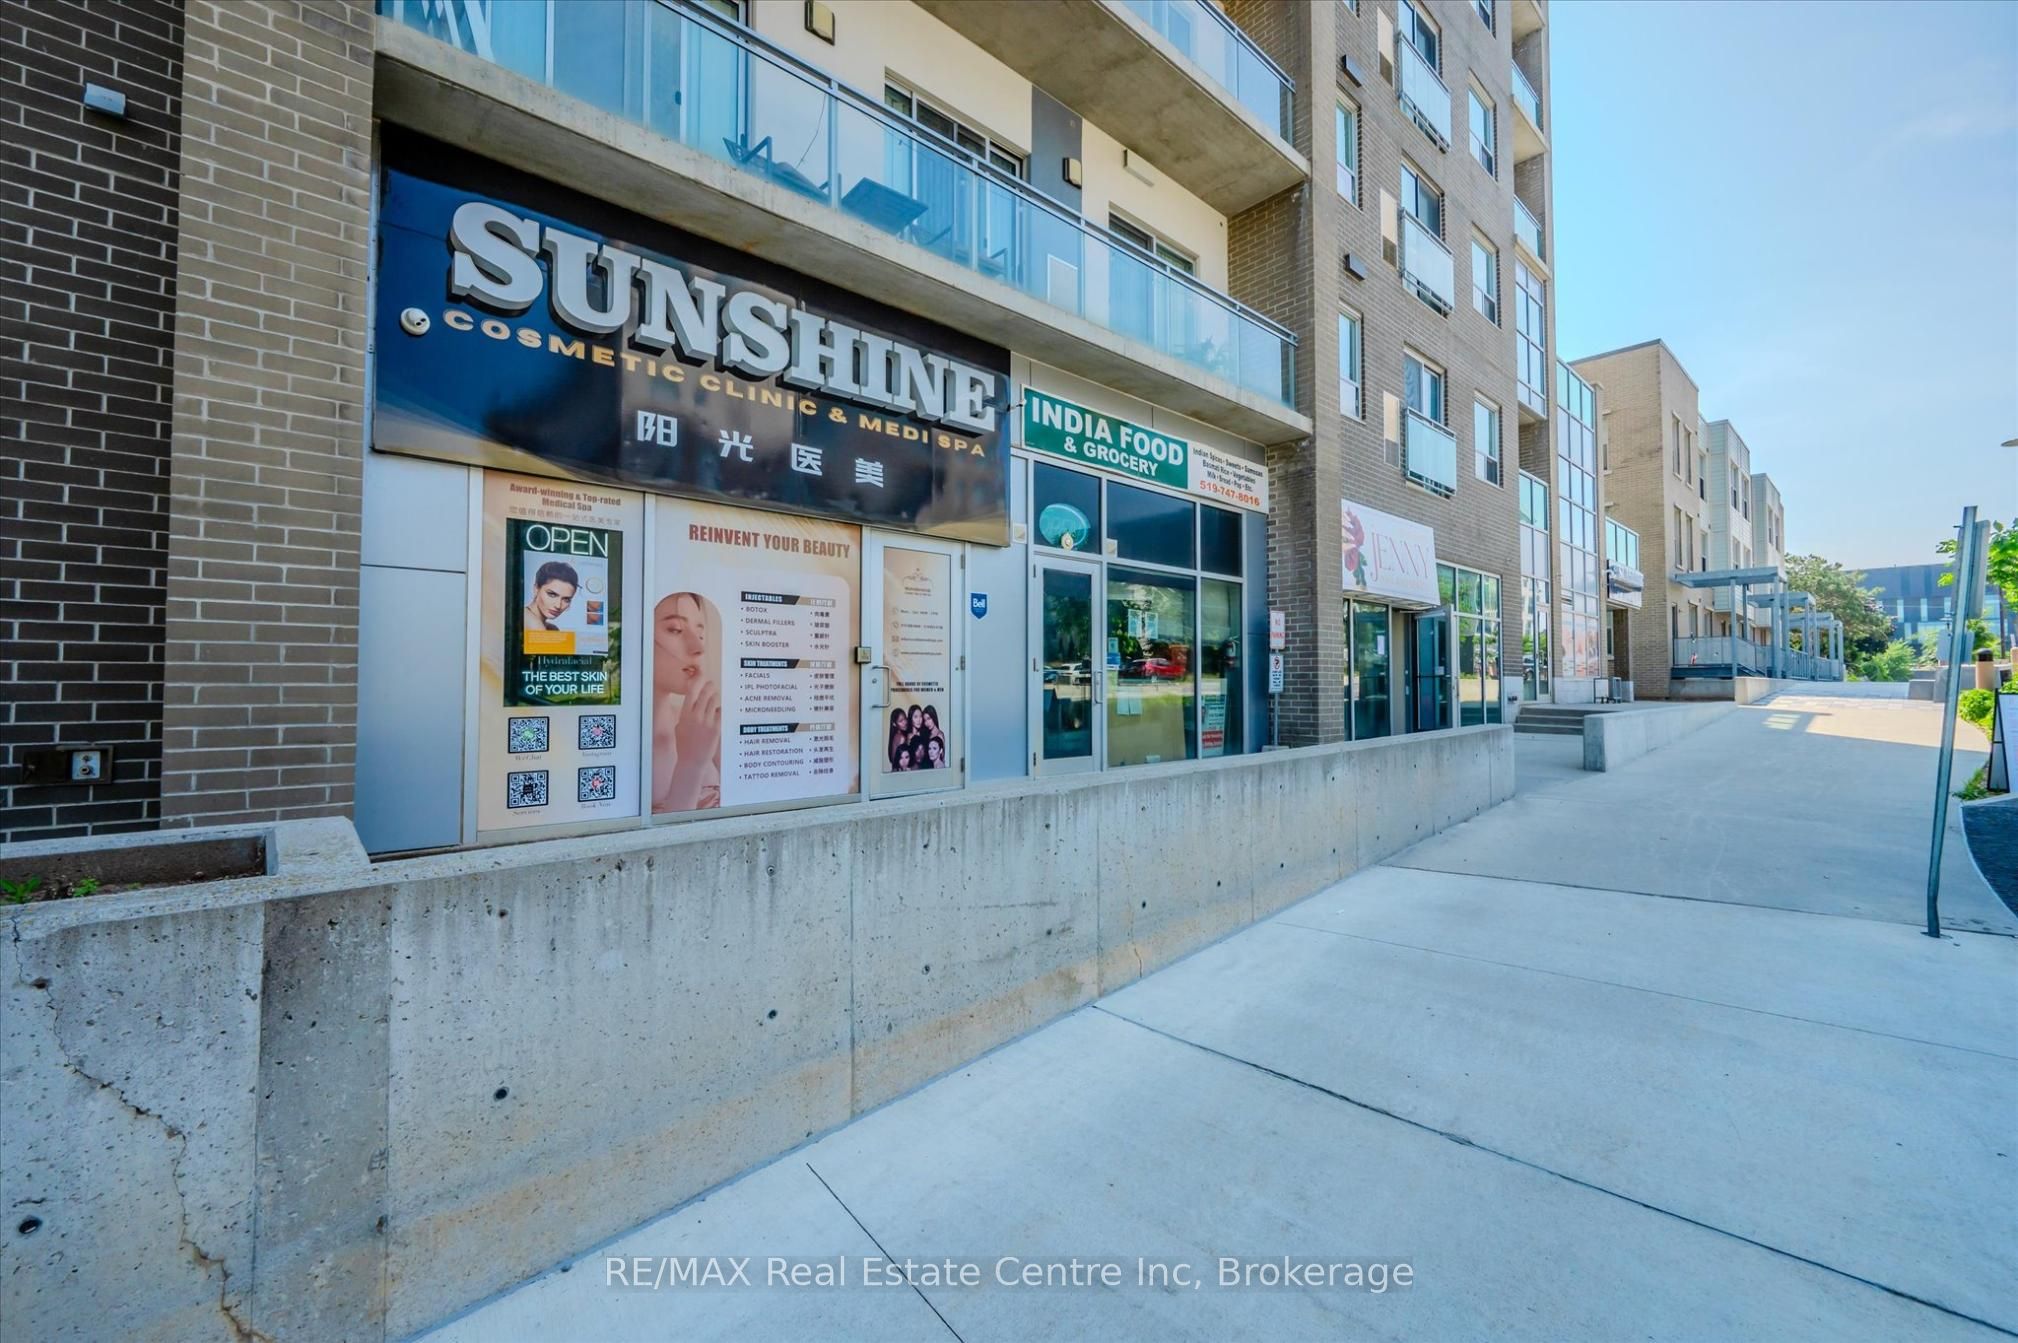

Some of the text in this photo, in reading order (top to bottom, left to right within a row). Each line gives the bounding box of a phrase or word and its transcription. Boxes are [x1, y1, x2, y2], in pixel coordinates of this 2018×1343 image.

[449, 201, 996, 435] SUNSHINE
[443, 308, 986, 458] COSMETIC CLINIC & MEDI SPA
[1031, 396, 1184, 467] INDIA FOOD
[637, 409, 884, 488] 阳光医美
[1063, 436, 1159, 477] & GROCERY
[510, 483, 574, 500] Award-winning
[582, 493, 621, 506] Top-rated
[542, 498, 592, 512] Medical Spa
[526, 524, 608, 558] OPEN
[688, 524, 850, 559] REINVENT YOUR BEAUTY
[1370, 531, 1431, 582] JENNY
[973, 598, 985, 608] Bell
[745, 617, 771, 625] DERMAL
[522, 671, 608, 682] THE BEST SKIN
[525, 684, 604, 695] OF YOUR LIFE
[761, 748, 804, 756] RESTORATION
[763, 759, 804, 767] CONTOURING
[744, 770, 800, 780] TATTOO REMOVAL
